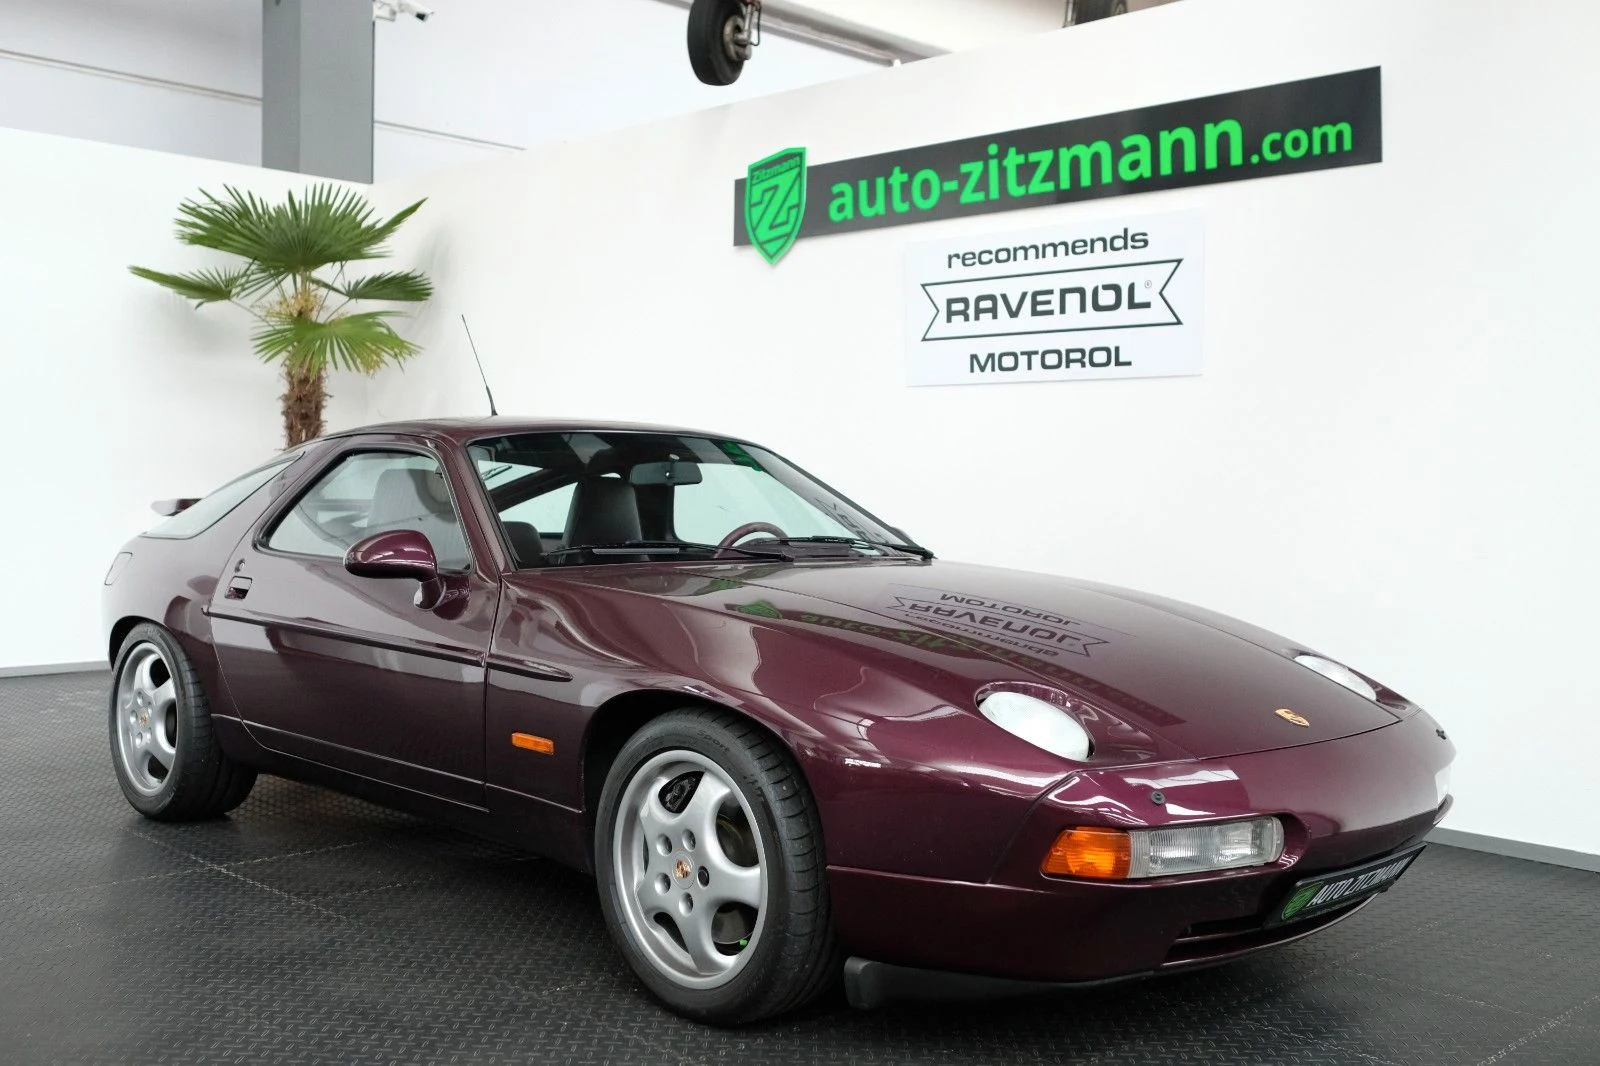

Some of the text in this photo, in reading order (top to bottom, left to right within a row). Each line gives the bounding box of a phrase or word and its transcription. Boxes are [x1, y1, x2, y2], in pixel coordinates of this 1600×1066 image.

[828, 118, 1353, 222] auto-zitzmann.com
[947, 227, 1150, 269] recommends
[969, 346, 1132, 374] MOTOROL
[1305, 877, 1355, 907] AUTO
